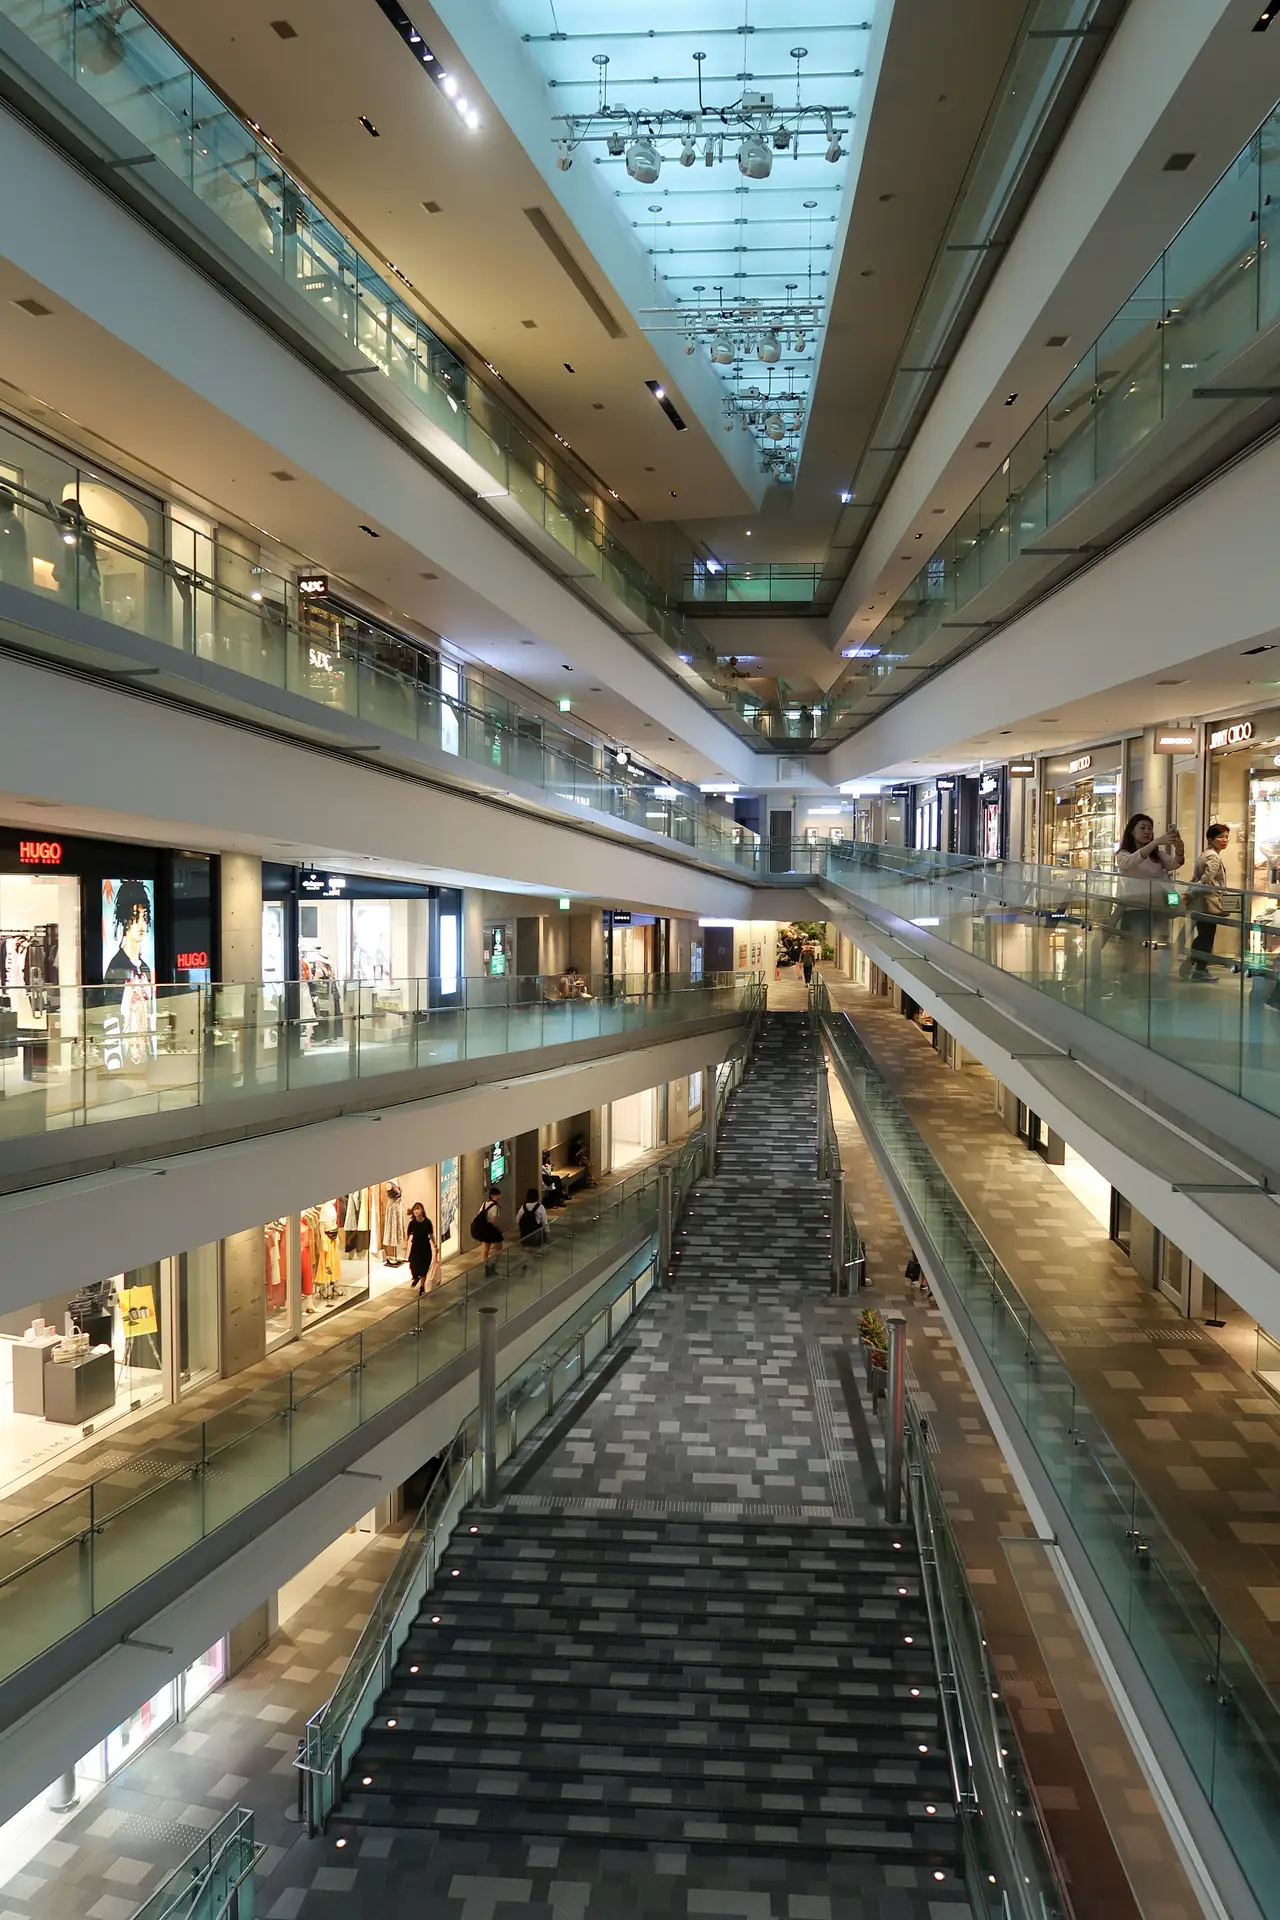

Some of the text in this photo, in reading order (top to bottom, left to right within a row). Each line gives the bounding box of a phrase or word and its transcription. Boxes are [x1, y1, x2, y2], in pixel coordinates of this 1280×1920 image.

[1228, 721, 1252, 744] CHOO
[20, 841, 62, 859] HUGO
[177, 952, 208, 967] HUGO
